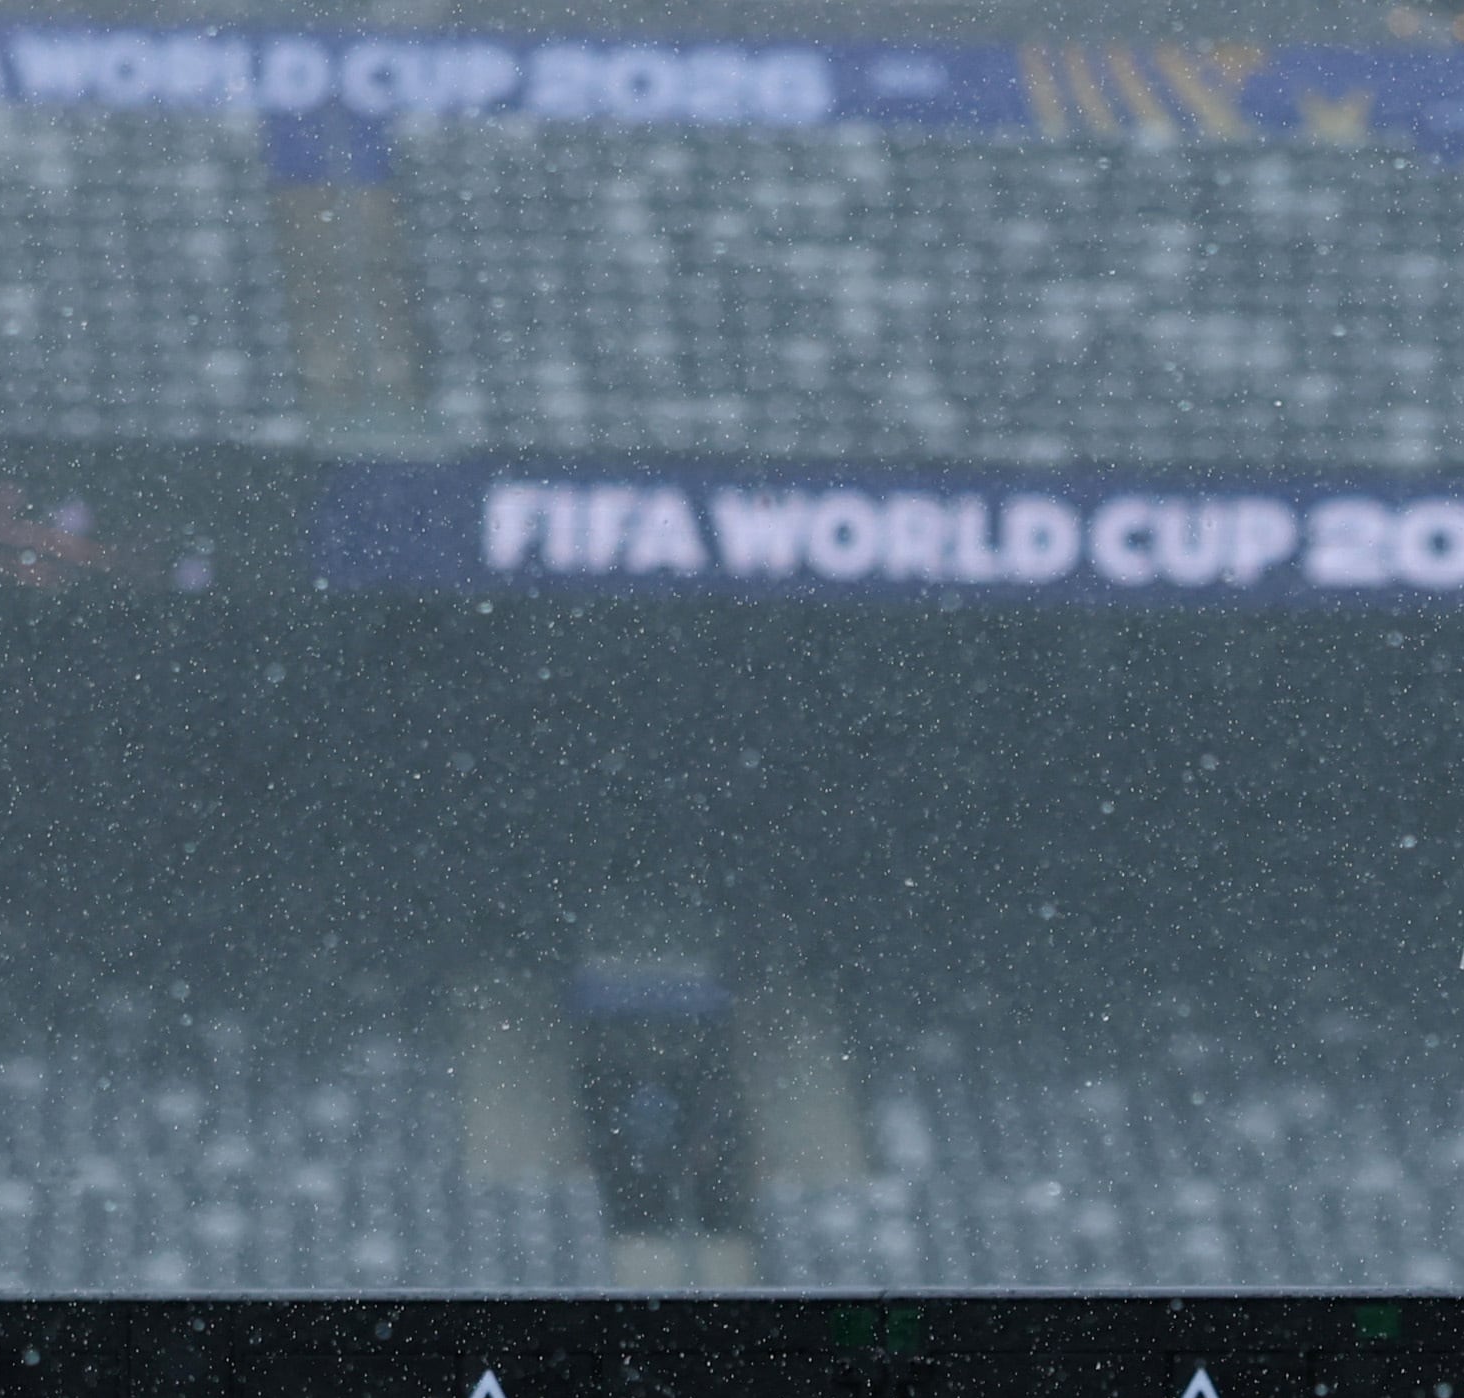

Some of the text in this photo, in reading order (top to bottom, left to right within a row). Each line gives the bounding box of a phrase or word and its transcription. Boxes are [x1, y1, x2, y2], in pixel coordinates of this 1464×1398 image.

[9, 34, 333, 112] WORLD
[341, 38, 522, 116] CUP
[529, 42, 835, 122] 2026
[486, 488, 708, 574] FIFA
[715, 492, 1080, 578] WORLD
[1090, 499, 1297, 588] CUP
